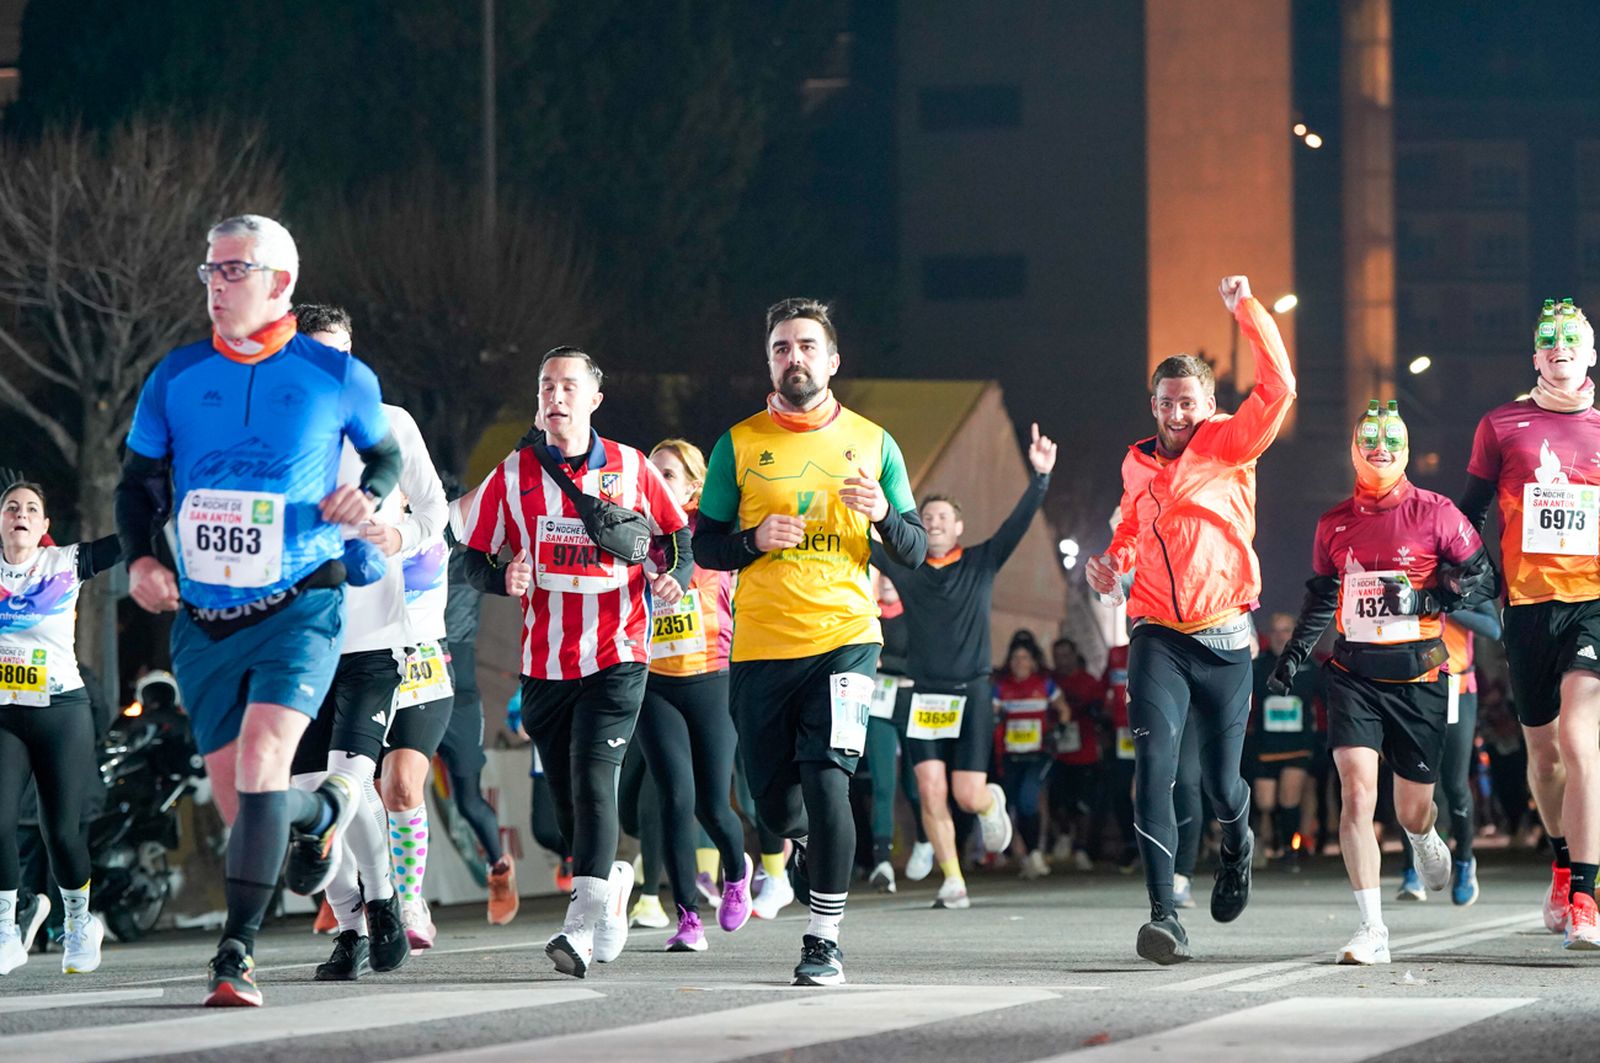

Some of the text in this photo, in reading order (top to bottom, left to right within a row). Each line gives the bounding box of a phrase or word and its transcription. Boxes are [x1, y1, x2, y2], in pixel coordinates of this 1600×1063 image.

[1542, 490, 1565, 499] NOCHE
[1533, 499, 1548, 508] SAN
[190, 511, 208, 521] SAN
[1540, 508, 1586, 531] 6973
[555, 526, 580, 535] NOCHE
[196, 524, 262, 555] 6363
[545, 533, 561, 543] SAN
[796, 526, 841, 552] aén
[1356, 598, 1390, 618] 432
[918, 711, 957, 724] 13650
